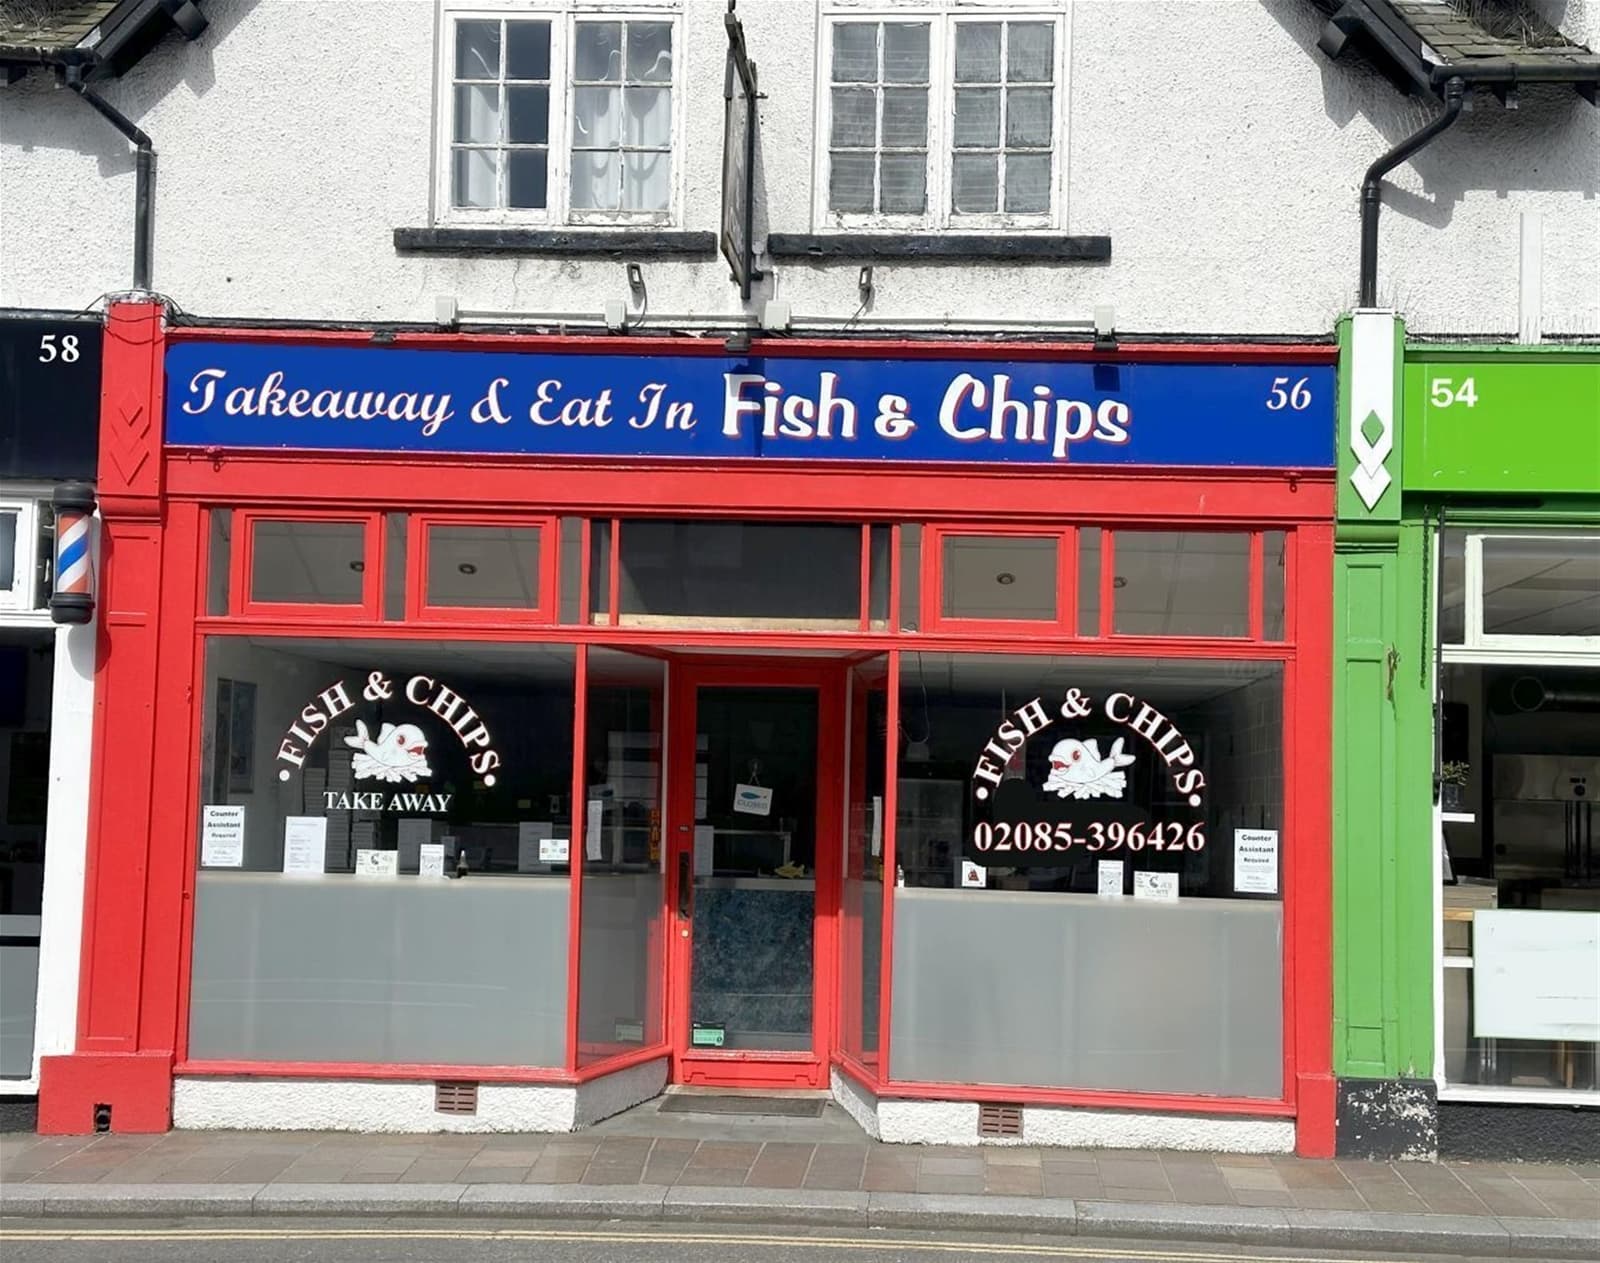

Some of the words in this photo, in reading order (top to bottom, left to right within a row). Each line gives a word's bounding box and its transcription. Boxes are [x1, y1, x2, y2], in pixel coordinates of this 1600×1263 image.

[38, 334, 80, 363] 58
[1265, 376, 1312, 411] 56
[1430, 377, 1479, 408] 54
[181, 368, 454, 437] Takeaway
[470, 377, 512, 426] &
[529, 379, 613, 429] Eat
[628, 383, 698, 431] In
[722, 371, 857, 439] Fish
[875, 393, 916, 439] &
[938, 372, 1131, 459] Chips
[276, 680, 355, 769] FISH
[362, 670, 394, 701] &
[405, 675, 501, 775] CHIPS
[972, 697, 1054, 788] FISH
[1060, 687, 1092, 719] &
[1104, 691, 1207, 794] CHIPS
[209, 810, 239, 818] Counter
[323, 791, 384, 811] TAKE
[388, 792, 452, 813] AWAY
[207, 821, 241, 829] Assistant
[973, 821, 1206, 853] 02085-396426
[1241, 834, 1272, 842] Counter
[1239, 845, 1274, 853] Assistant
